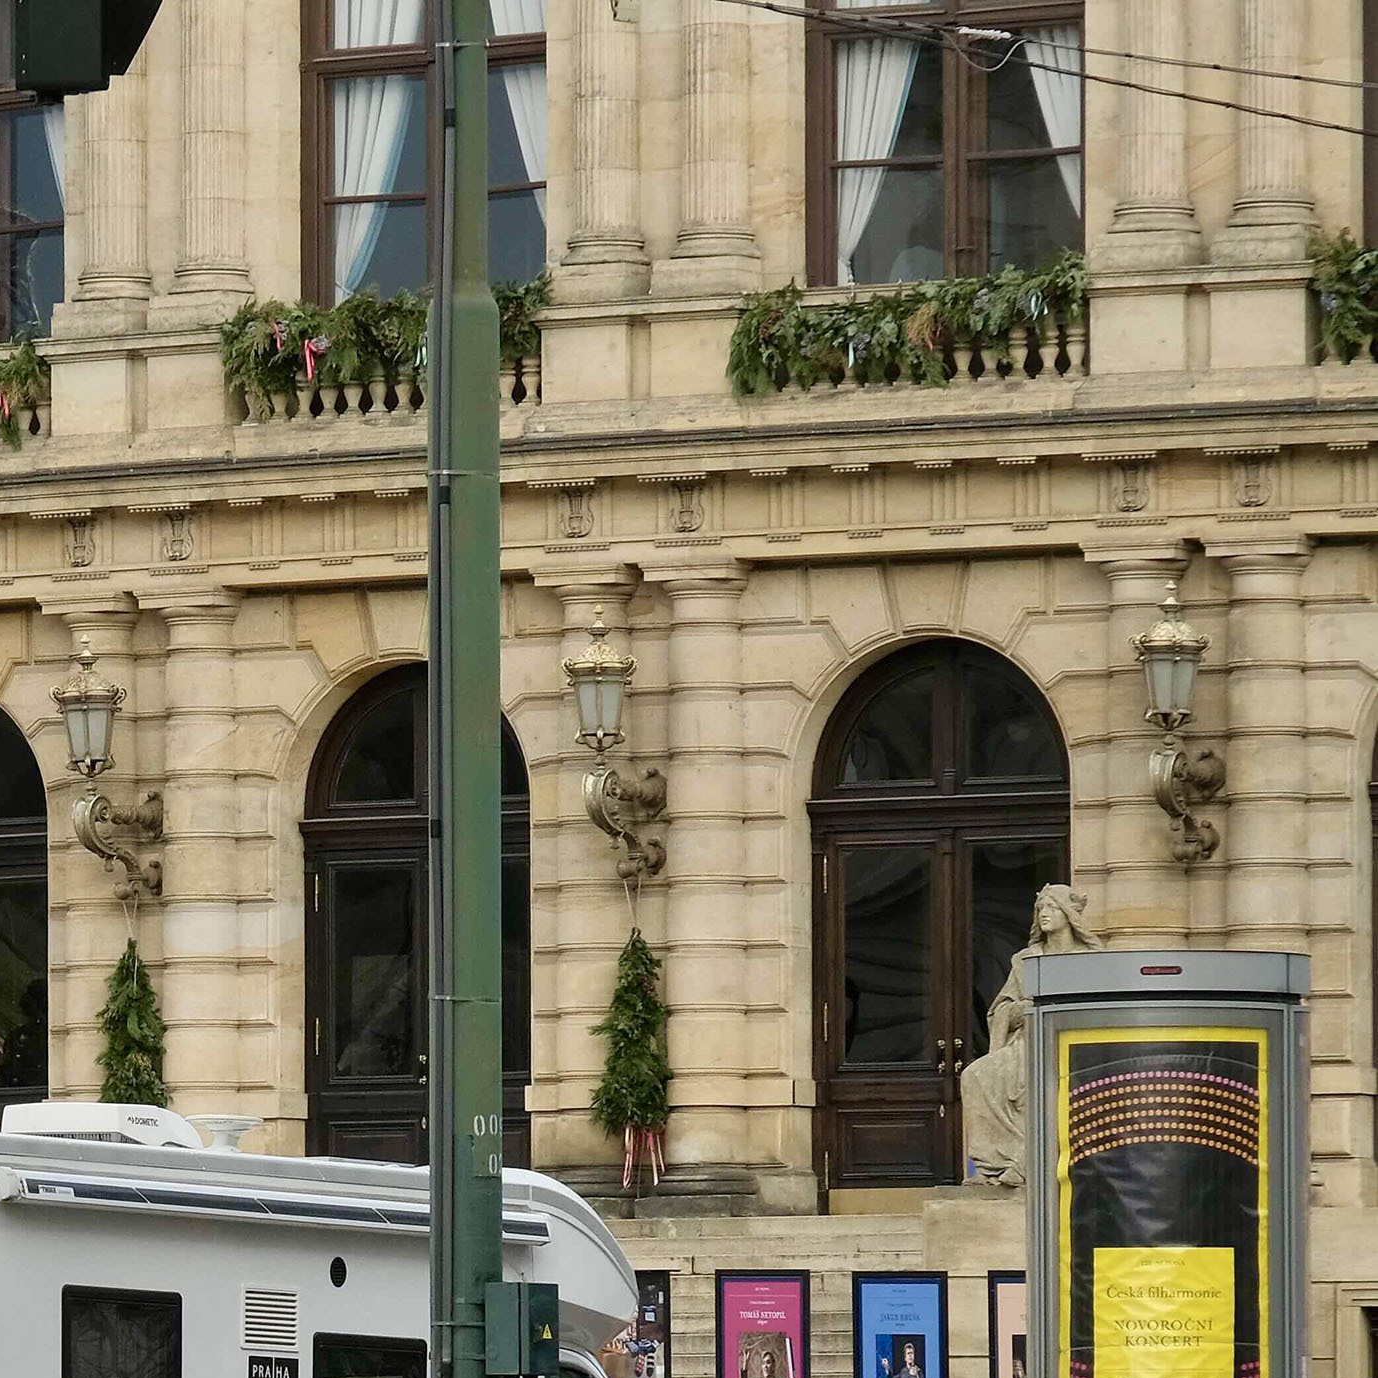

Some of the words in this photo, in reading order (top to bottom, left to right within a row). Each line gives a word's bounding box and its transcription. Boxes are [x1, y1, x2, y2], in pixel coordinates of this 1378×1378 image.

[1106, 1284, 1143, 1299] Česká
[1148, 1286, 1222, 1299] filharmonie
[1114, 1317, 1212, 1331] NOVOROČNÍ
[1125, 1335, 1203, 1347] KONCERT
